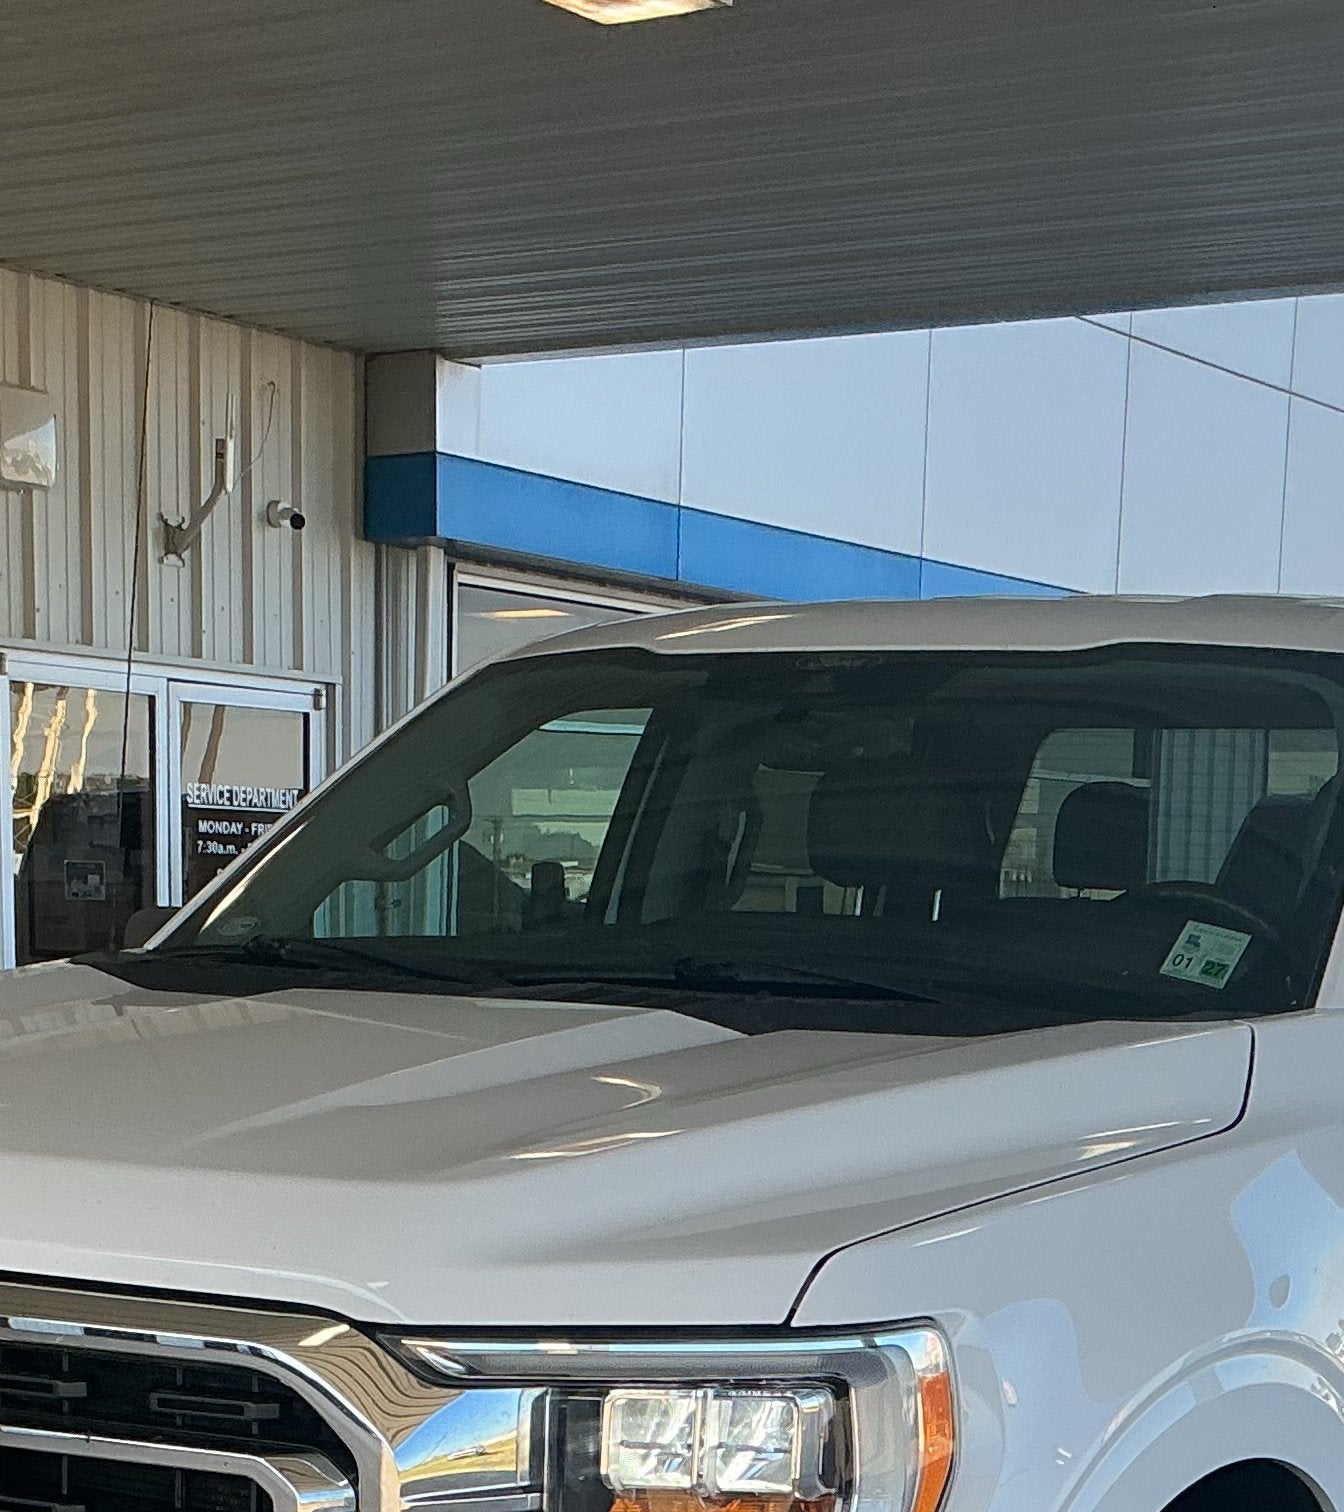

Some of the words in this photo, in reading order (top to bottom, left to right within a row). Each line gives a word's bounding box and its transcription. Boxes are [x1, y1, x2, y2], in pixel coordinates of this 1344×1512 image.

[186, 783, 231, 806] SERVICE
[232, 785, 299, 809] DEPARTMENT
[198, 820, 243, 834] MONDAY
[1172, 953, 1193, 969] 01
